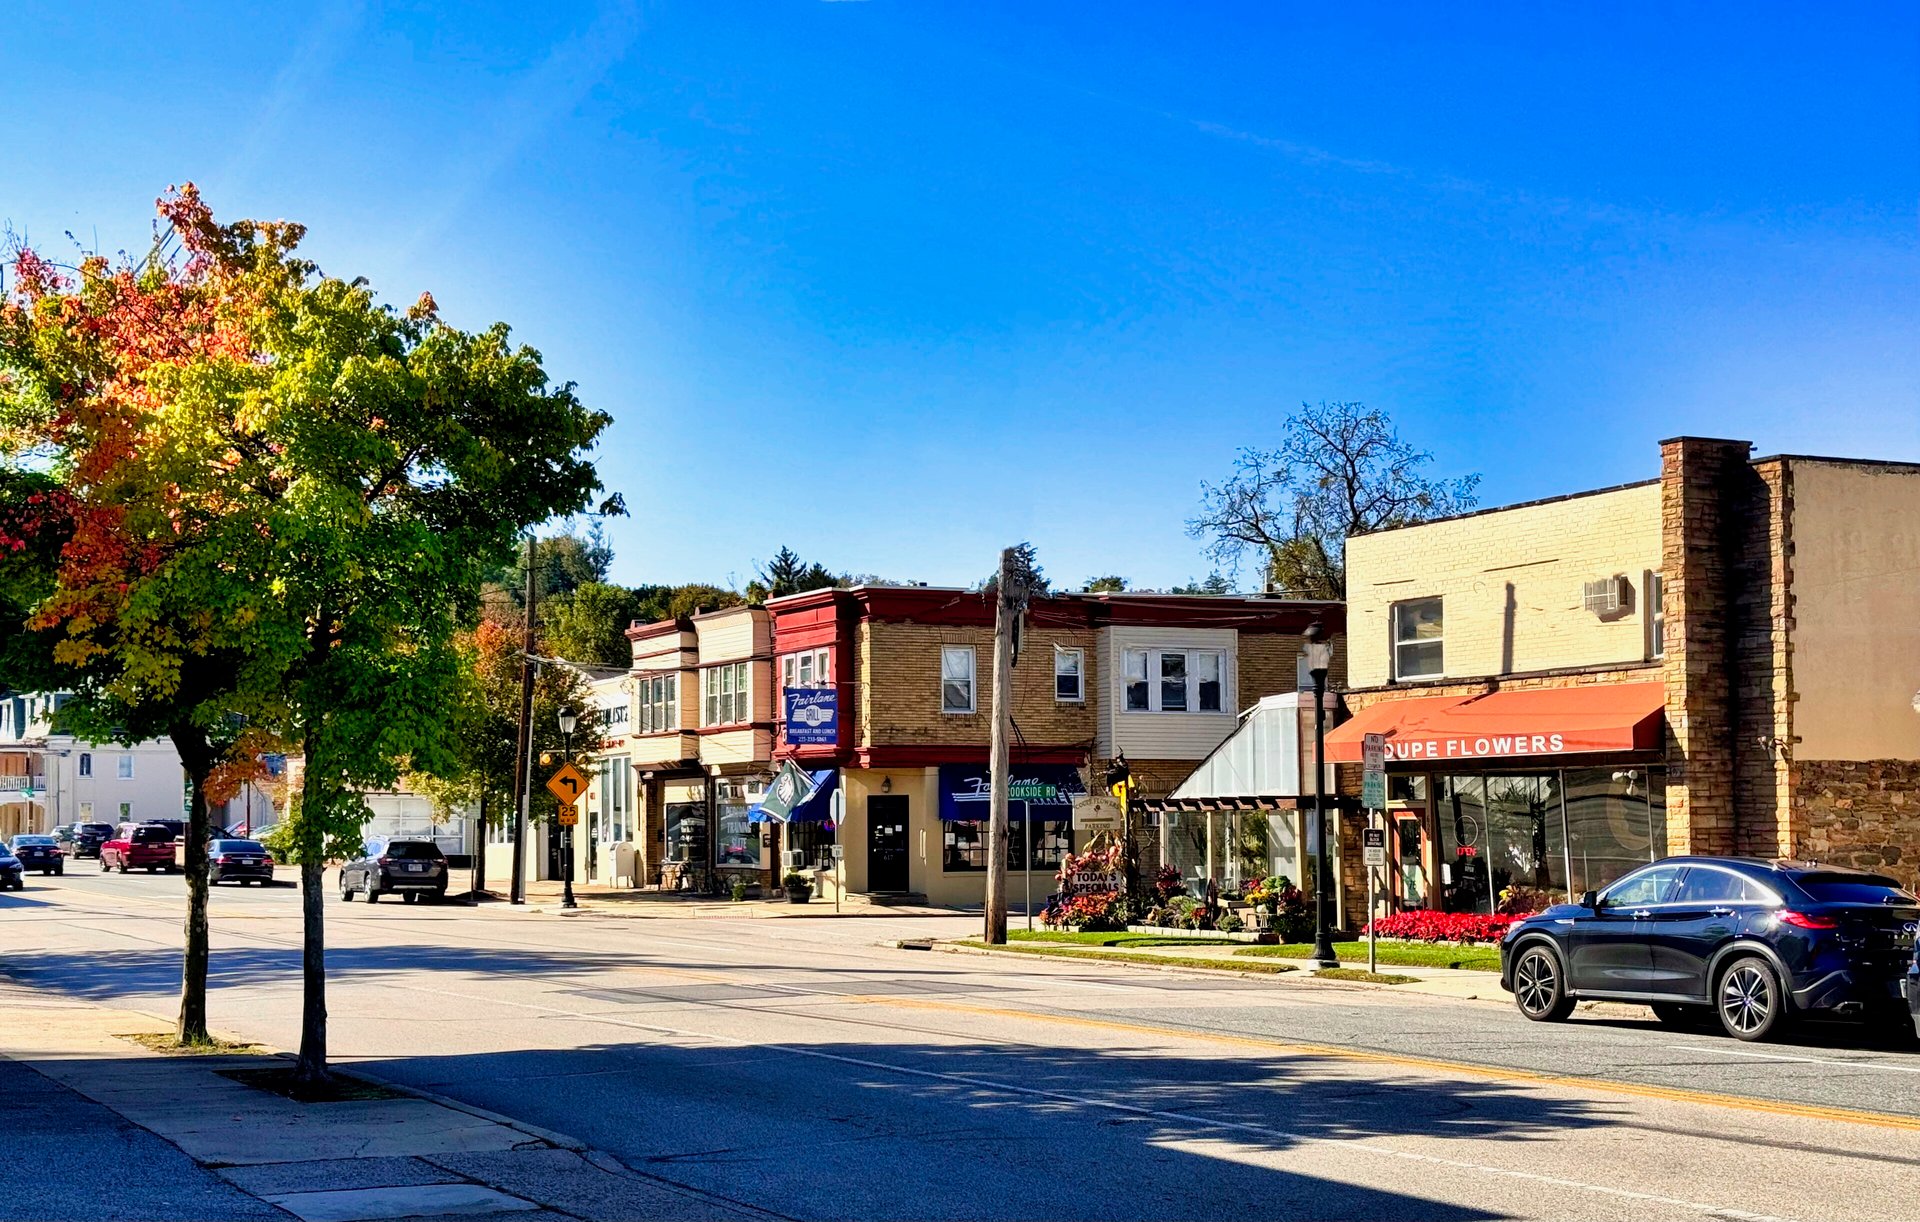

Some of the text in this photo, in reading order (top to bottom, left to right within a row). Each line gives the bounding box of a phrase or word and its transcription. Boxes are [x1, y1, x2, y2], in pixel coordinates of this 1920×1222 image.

[788, 691, 837, 709] Fairlane
[806, 709, 820, 721] GRILL
[1384, 734, 1564, 759] OUPE FLOWERS
[1046, 786, 1056, 797] RD
[562, 806, 576, 817] 25
[1456, 846, 1478, 856] OPEN
[1073, 883, 1119, 893] SPECIALS
